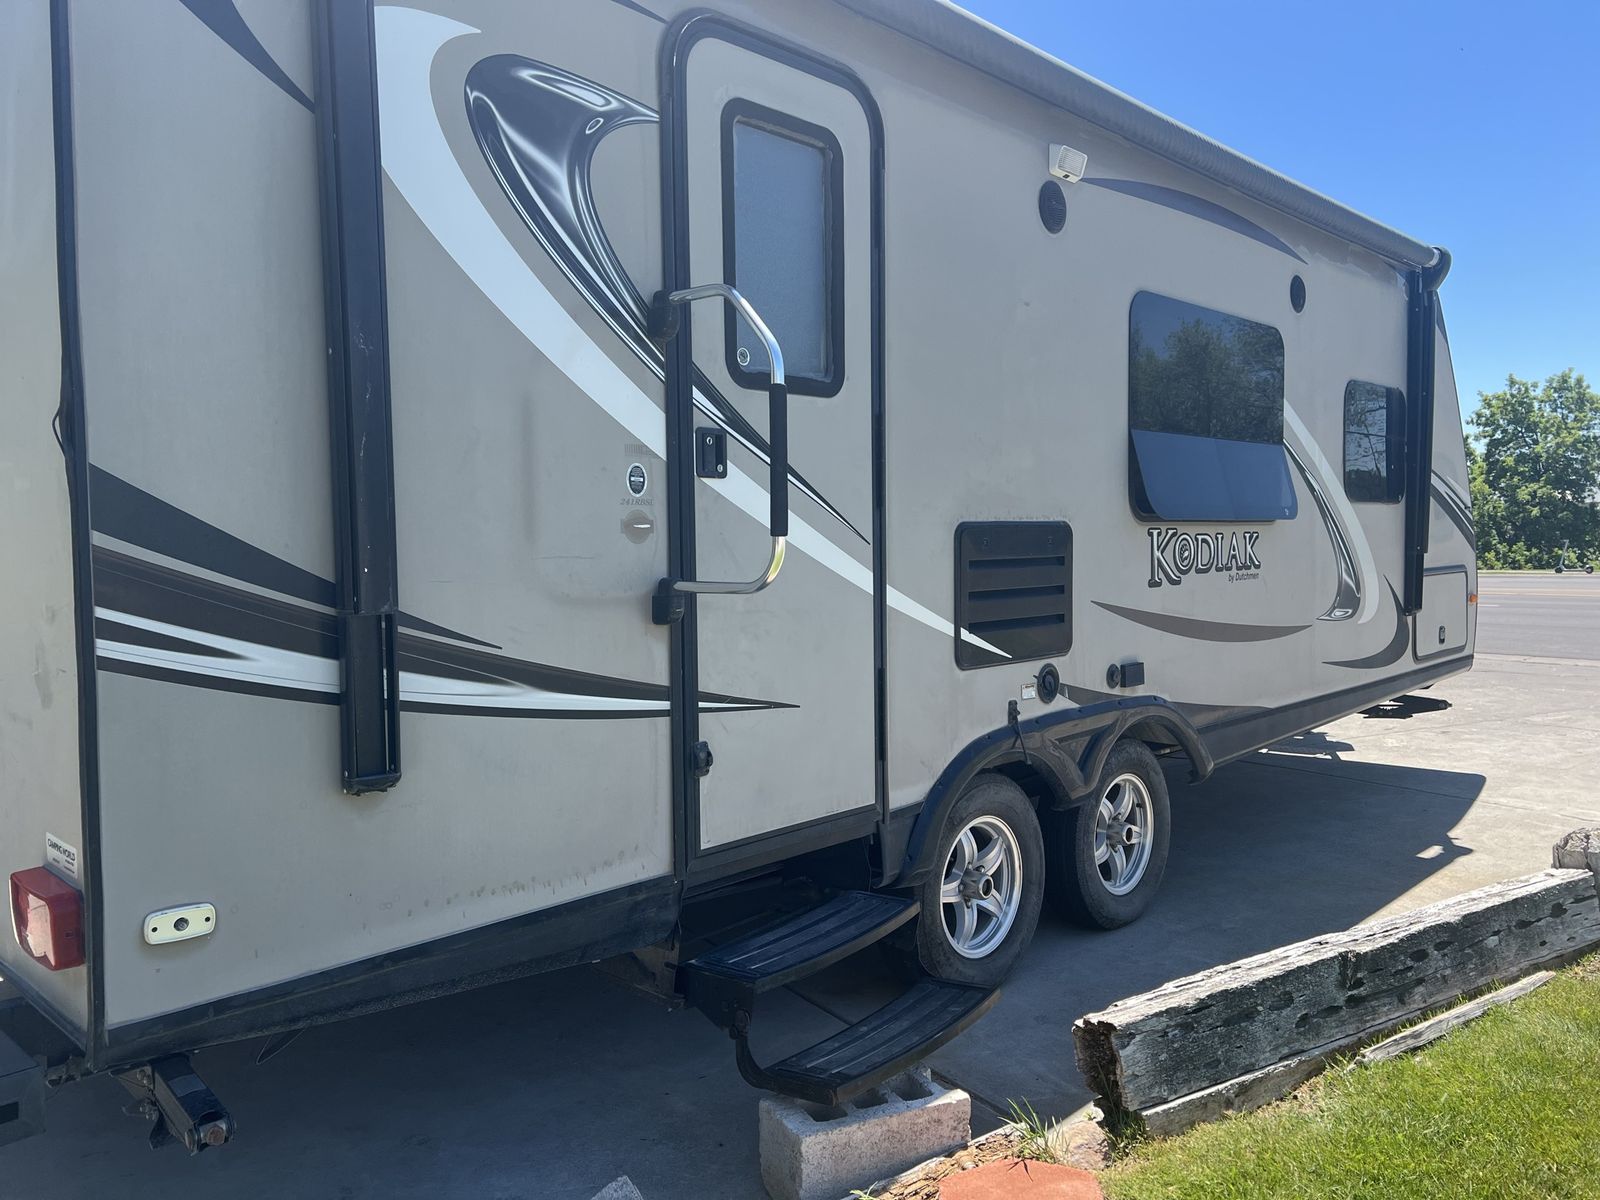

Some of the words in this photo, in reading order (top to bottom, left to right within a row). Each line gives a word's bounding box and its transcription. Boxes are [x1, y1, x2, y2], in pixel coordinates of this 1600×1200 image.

[1147, 527, 1261, 588] KODIAK
[1228, 573, 1235, 583] by
[1235, 572, 1260, 581] Dutchmen
[62, 848, 76, 862] WORLD
